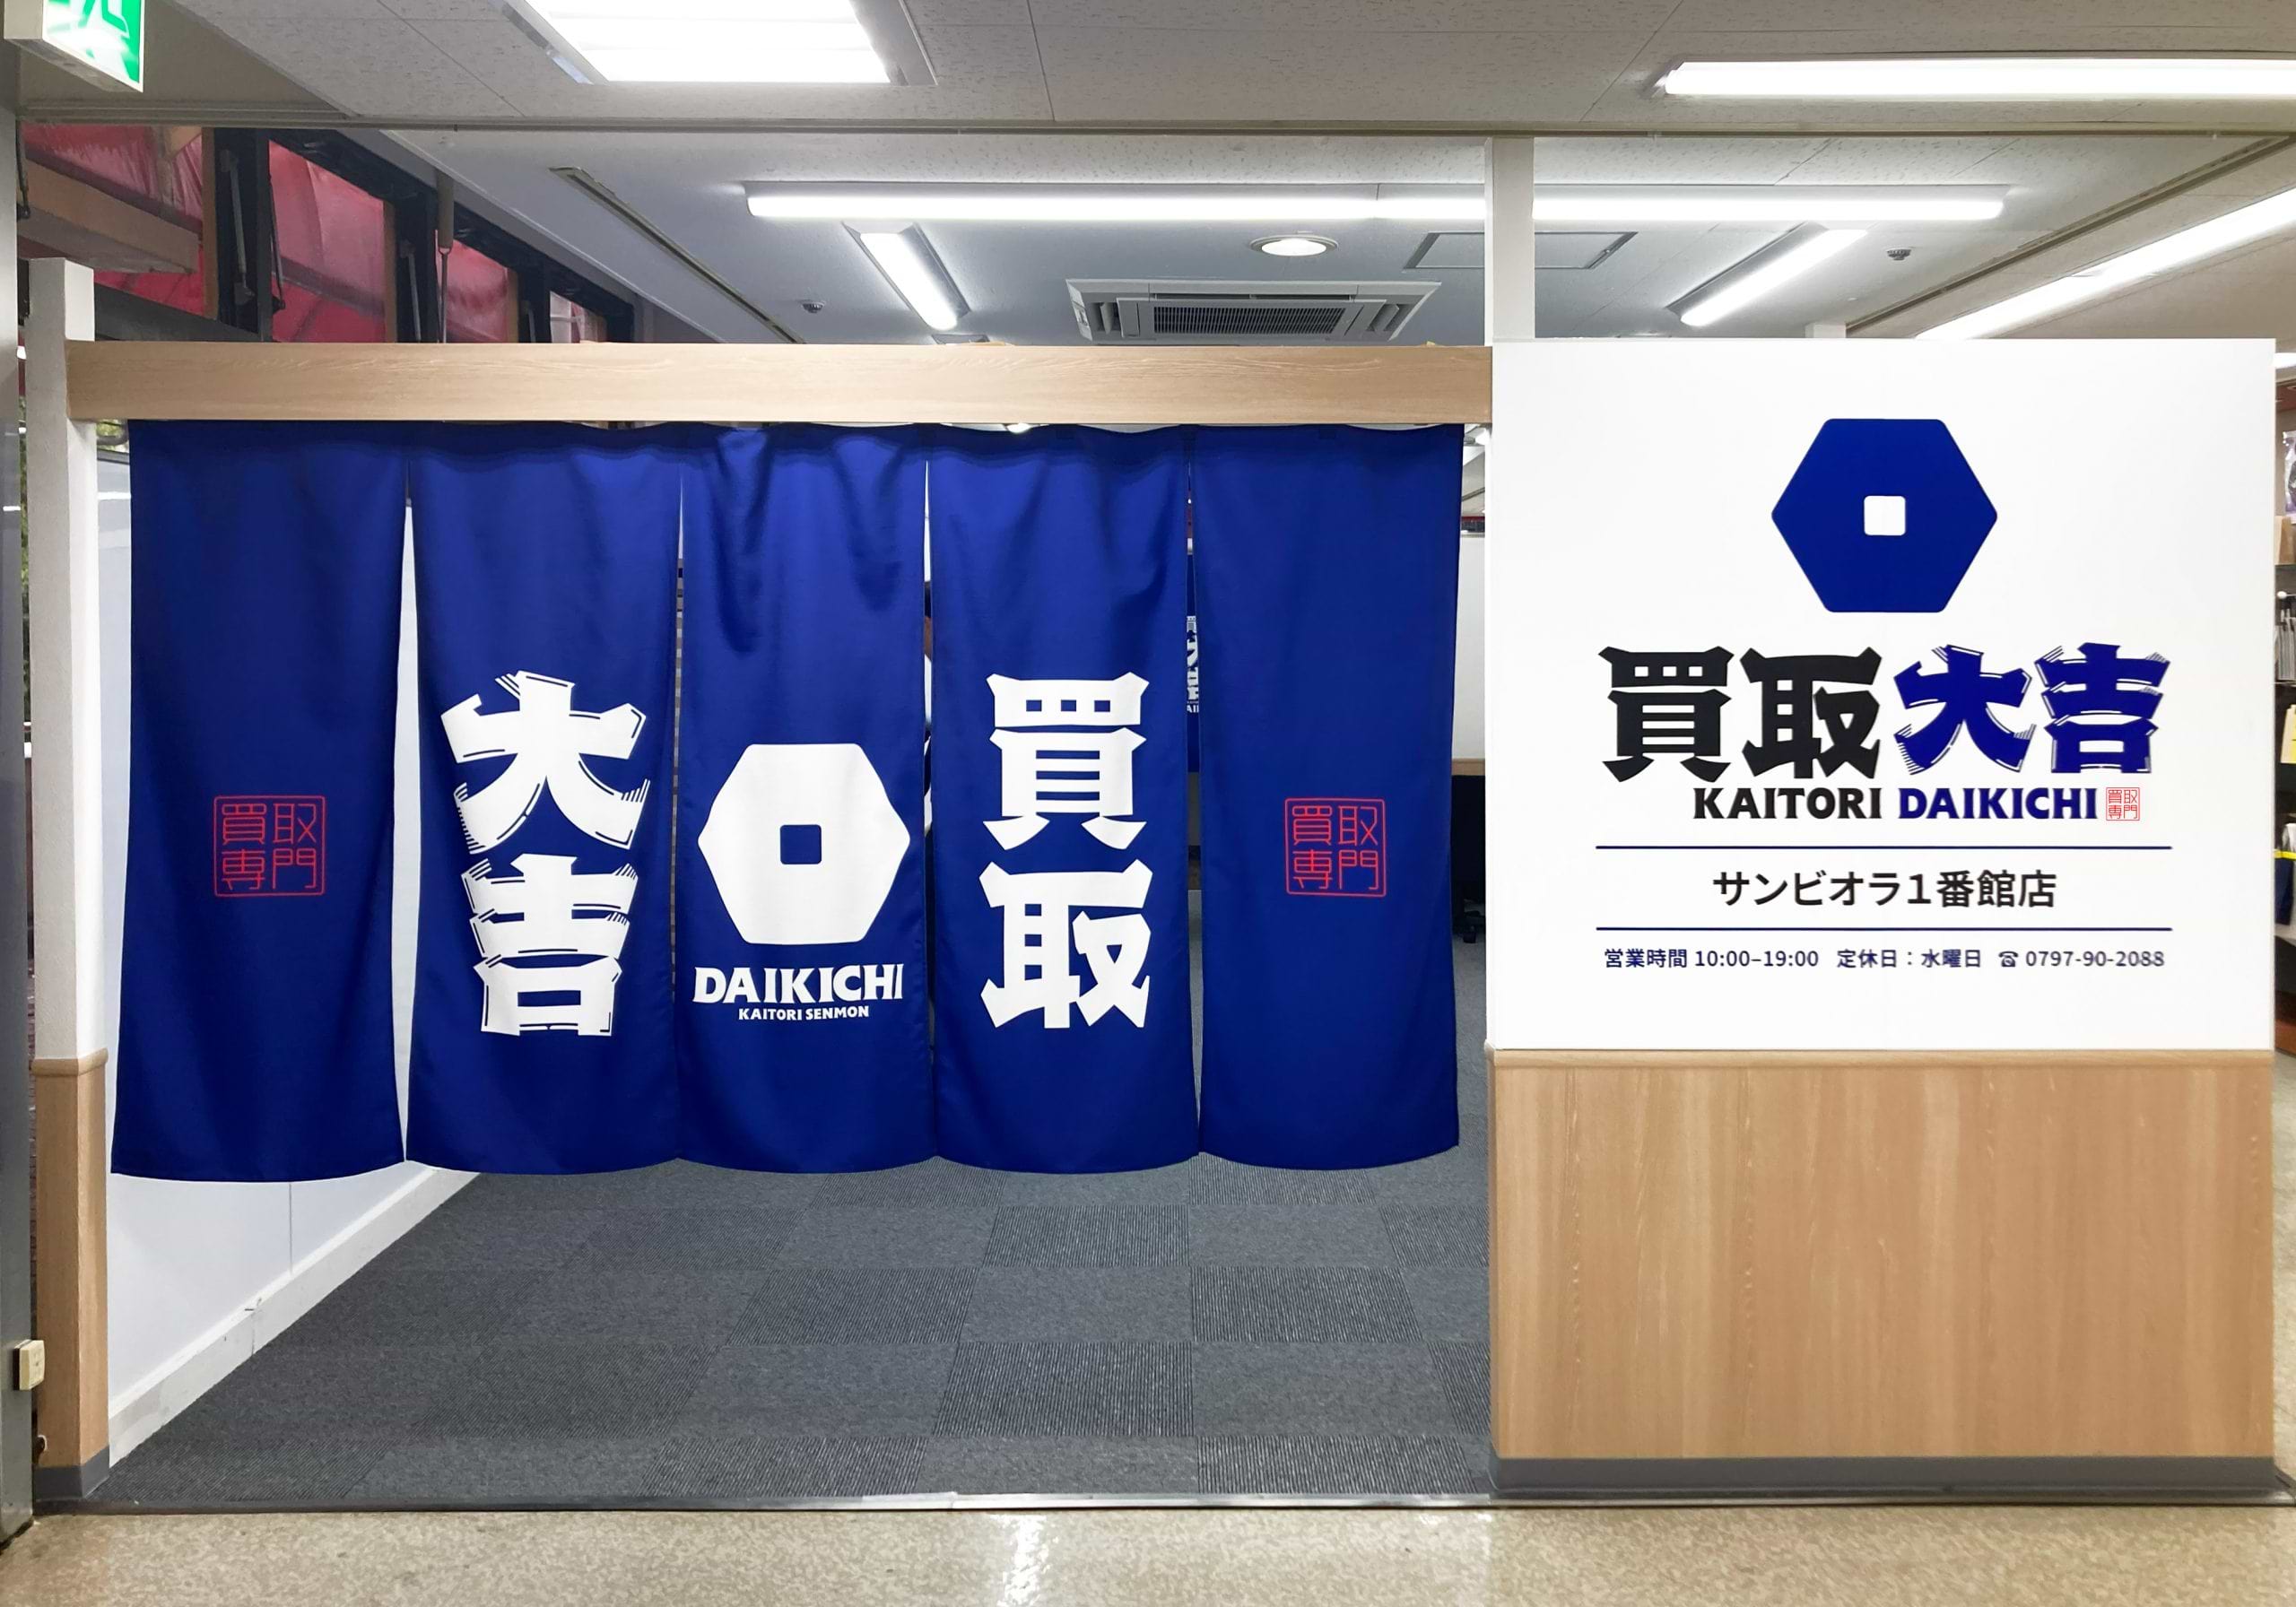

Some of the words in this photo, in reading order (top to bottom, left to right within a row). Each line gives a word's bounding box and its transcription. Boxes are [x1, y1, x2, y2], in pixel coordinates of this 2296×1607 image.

[1598, 641, 2171, 782] 買取大吉
[1692, 787, 1883, 820] KAITORI
[1898, 787, 2098, 820] DAIKICHI
[440, 670, 650, 1037] 大吉
[978, 672, 1153, 1029] 買取
[1712, 869, 2057, 908] サンビオラ1番館店
[1604, 949, 1688, 969] 営業時間
[2025, 951, 2165, 967] 0797-90-2088
[692, 963, 904, 1004] DAIKICHI
[738, 1007, 803, 1021] KAITORI
[805, 1005, 870, 1021] SENMON
